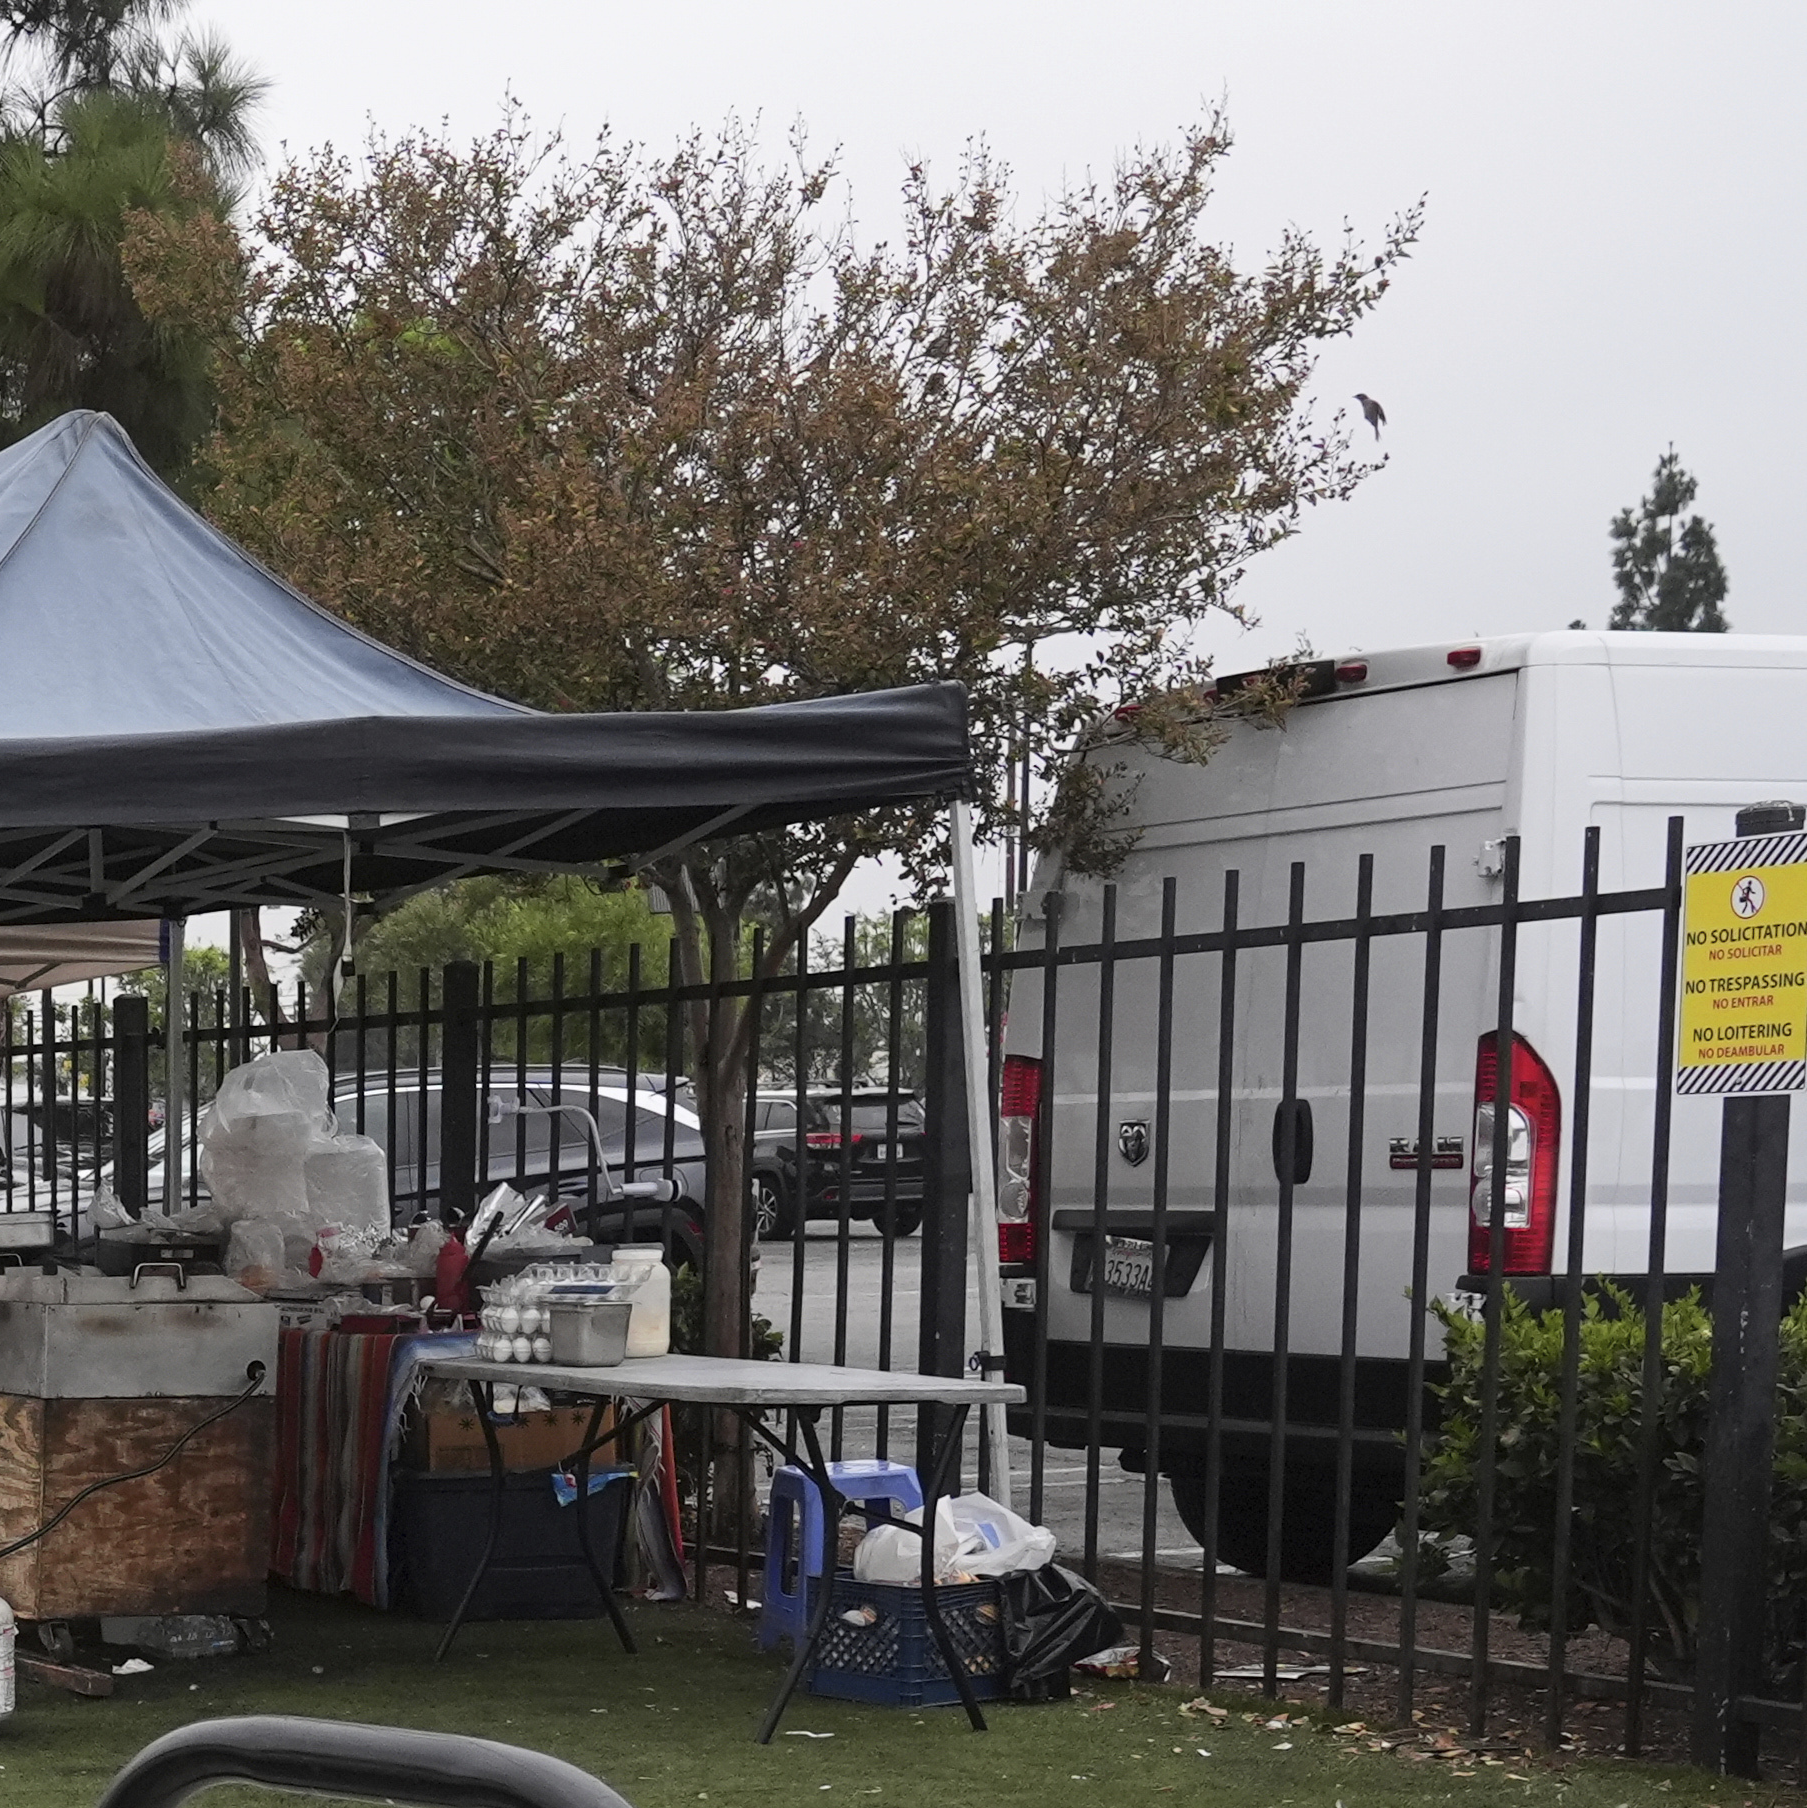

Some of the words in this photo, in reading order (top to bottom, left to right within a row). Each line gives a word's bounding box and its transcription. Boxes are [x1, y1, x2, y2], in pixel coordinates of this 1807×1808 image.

[1686, 930, 1707, 946] NO
[1710, 921, 1807, 944] SOLICITATION
[1708, 949, 1725, 961] NO
[1727, 944, 1782, 960] SOLICITAR
[1685, 978, 1706, 994] NO
[1709, 972, 1805, 992] TRESPASSING
[1712, 998, 1729, 1010] NO
[1731, 995, 1774, 1008] ENTRAR
[1693, 1027, 1714, 1042] NO
[1717, 1022, 1792, 1041] LOITERING
[1698, 1048, 1715, 1059] NO
[1716, 1044, 1785, 1058] DEAMBULAR
